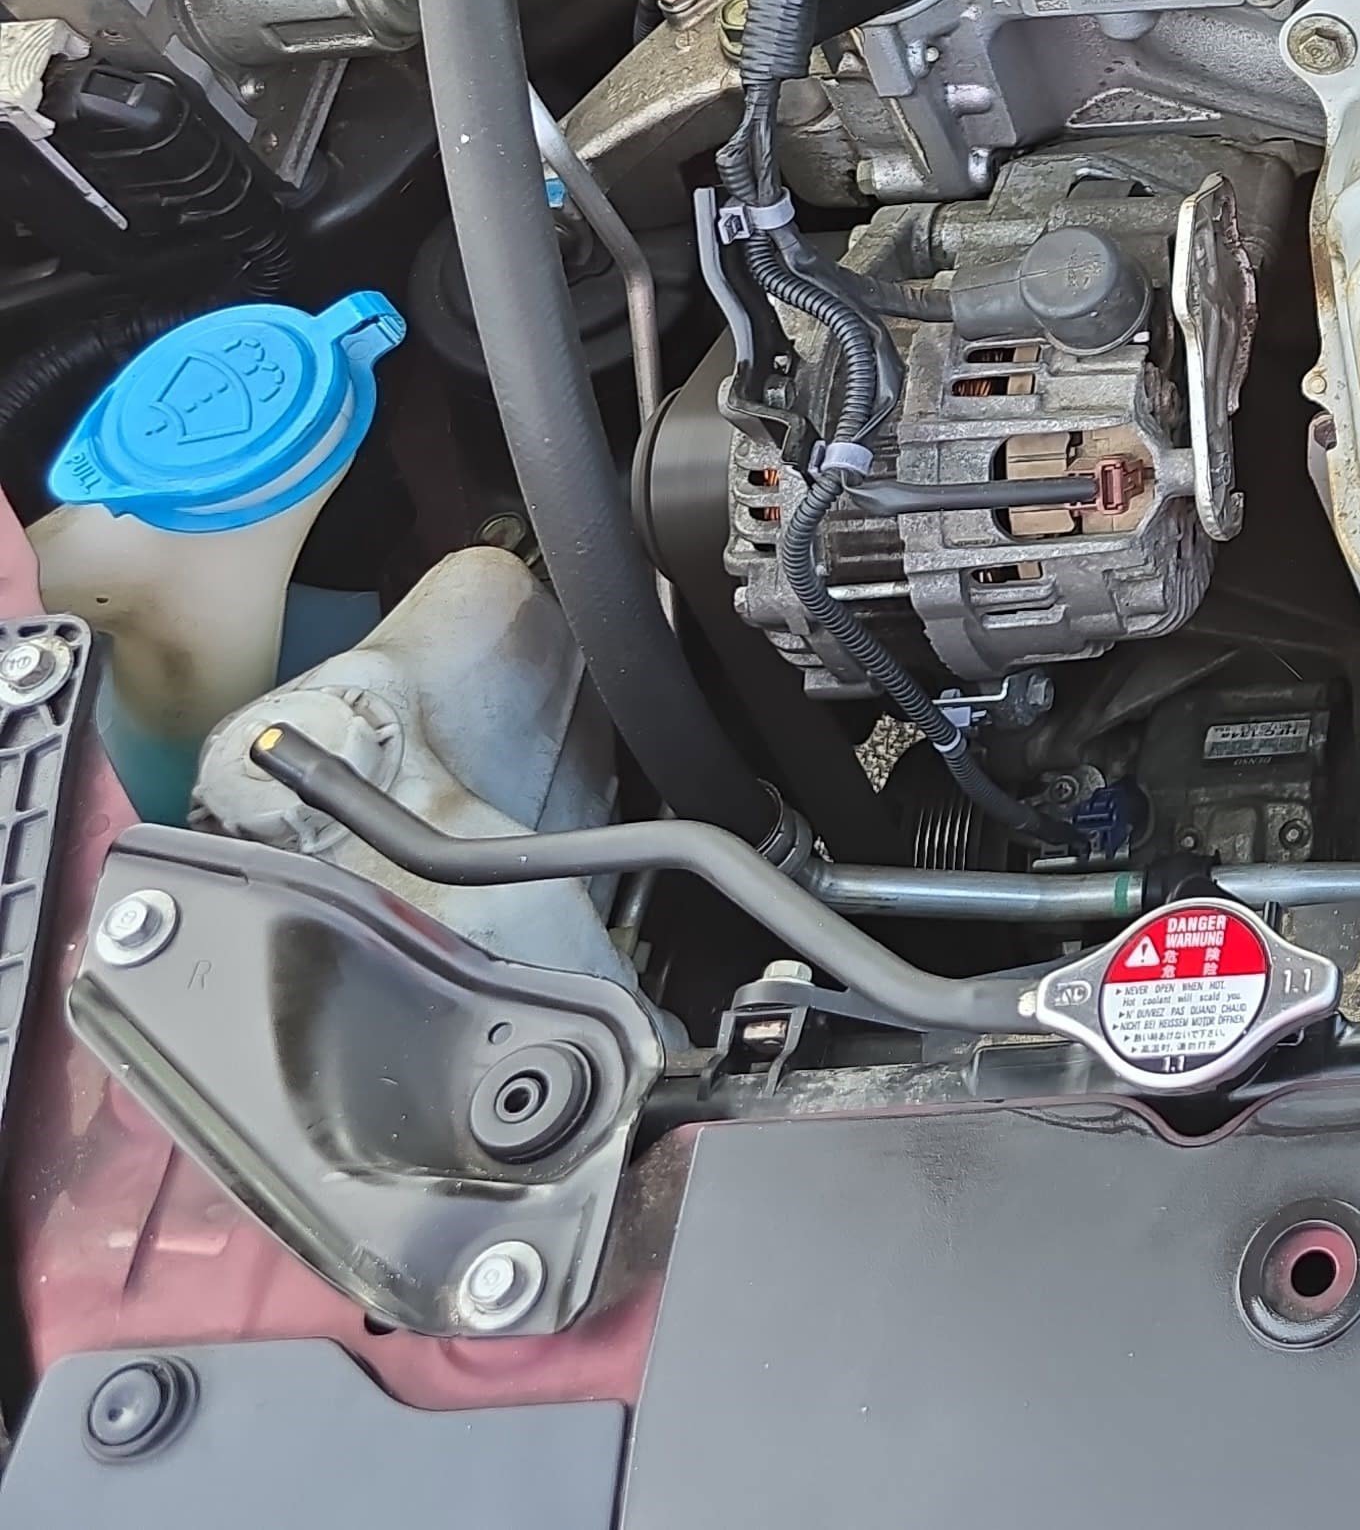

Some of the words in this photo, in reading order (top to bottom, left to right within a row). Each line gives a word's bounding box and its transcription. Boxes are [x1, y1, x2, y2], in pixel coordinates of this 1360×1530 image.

[65, 451, 101, 495] PULL
[1166, 914, 1228, 933] DANGER
[1165, 930, 1226, 949] WARNUNG
[1124, 985, 1149, 995] NEVER
[1155, 983, 1176, 994] OPEN
[1182, 981, 1204, 991] WHEN
[1283, 968, 1313, 995] 1.1
[1122, 997, 1136, 1007] Hot
[1142, 995, 1172, 1006] coolant
[1177, 993, 1193, 1003] will
[1200, 991, 1221, 1002] scald
[1136, 1007, 1166, 1018] OUVREZ
[1171, 1006, 1185, 1016] PAS
[1120, 1021, 1142, 1031] NICHT
[1144, 1019, 1156, 1030] BEI
[1158, 1018, 1189, 1029] HEISSEM
[1191, 1016, 1216, 1027] MOTOR
[1163, 1055, 1186, 1073] 1.1
